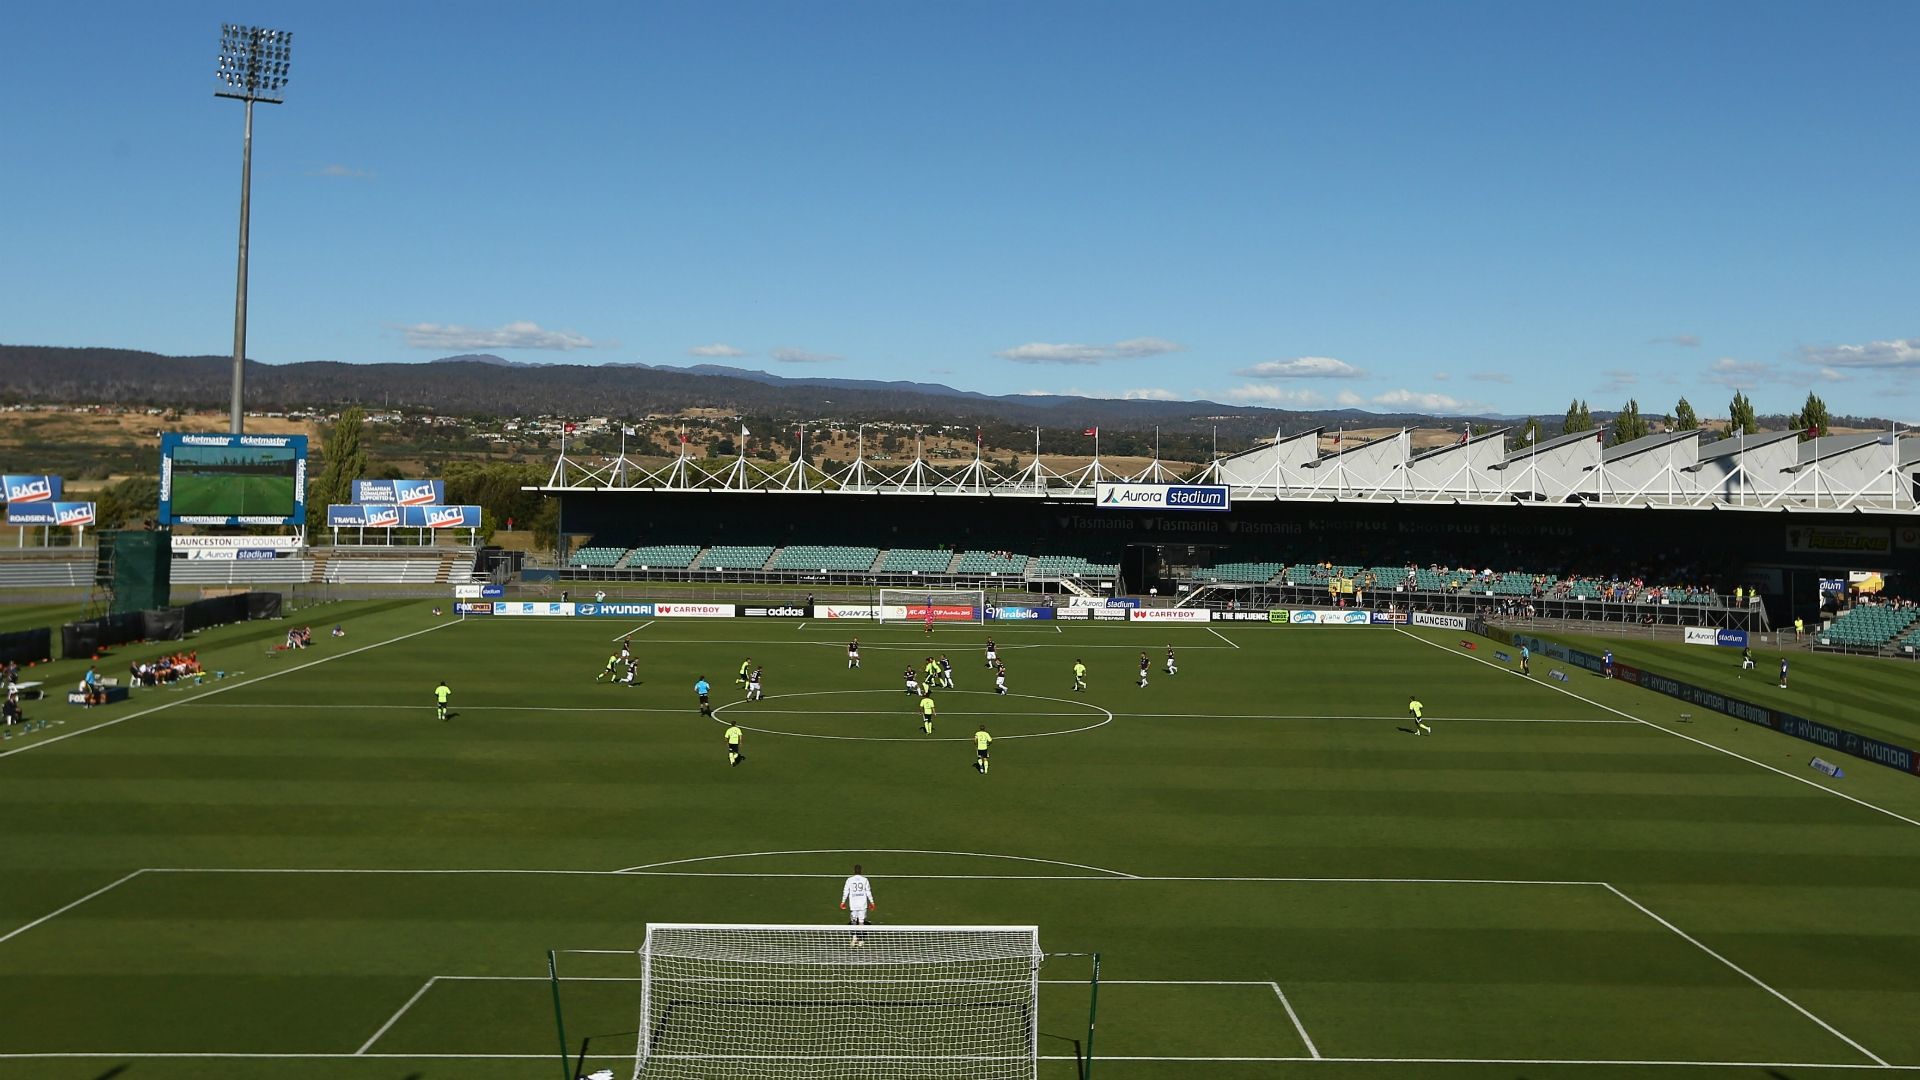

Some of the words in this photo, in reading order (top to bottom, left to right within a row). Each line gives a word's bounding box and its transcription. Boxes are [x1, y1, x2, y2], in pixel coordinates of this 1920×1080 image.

[182, 435, 233, 445] ticketmaster
[240, 436, 290, 446] ticketmaster
[12, 481, 45, 497] RACT
[402, 485, 430, 499] RACT
[1120, 490, 1162, 502] Aurora
[1170, 488, 1221, 504] stadium
[10, 515, 46, 523] ROADSIDE
[61, 507, 88, 521] RACT
[370, 510, 394, 523] RACT
[430, 508, 459, 523] RACT
[358, 517, 365, 525] by
[1072, 516, 1134, 529] Tasmania
[1155, 517, 1218, 532] Tasmania
[1238, 520, 1302, 535] Tasmania
[175, 538, 232, 546] LAUNCESTON
[232, 538, 251, 546] CITY
[252, 538, 289, 546] COUNCIL
[205, 550, 233, 559] Aurora
[239, 550, 273, 560] stadium
[456, 603, 473, 611] FOX
[1107, 599, 1135, 608] stadium
[601, 605, 652, 614] HYUNDAI
[768, 607, 804, 617] adidas
[986, 607, 1039, 619] Mirabella
[1212, 612, 1221, 620] BE
[1222, 612, 1234, 620] THE
[1235, 612, 1269, 620] INFLUENCE
[1372, 612, 1388, 621] FOX
[1415, 614, 1464, 628] LAUNCESTON
[1694, 632, 1714, 640] Aurora
[1719, 634, 1743, 642] stadium
[1651, 676, 1679, 695] HYUNDAI
[68, 693, 86, 703] FOX
[1694, 689, 1725, 710] HYUNDAI
[1746, 706, 1772, 726] FOOTBALL
[1798, 721, 1838, 746] HYUNDAI
[1862, 740, 1910, 769] HYUNDAI
[852, 882, 864, 893] 39
